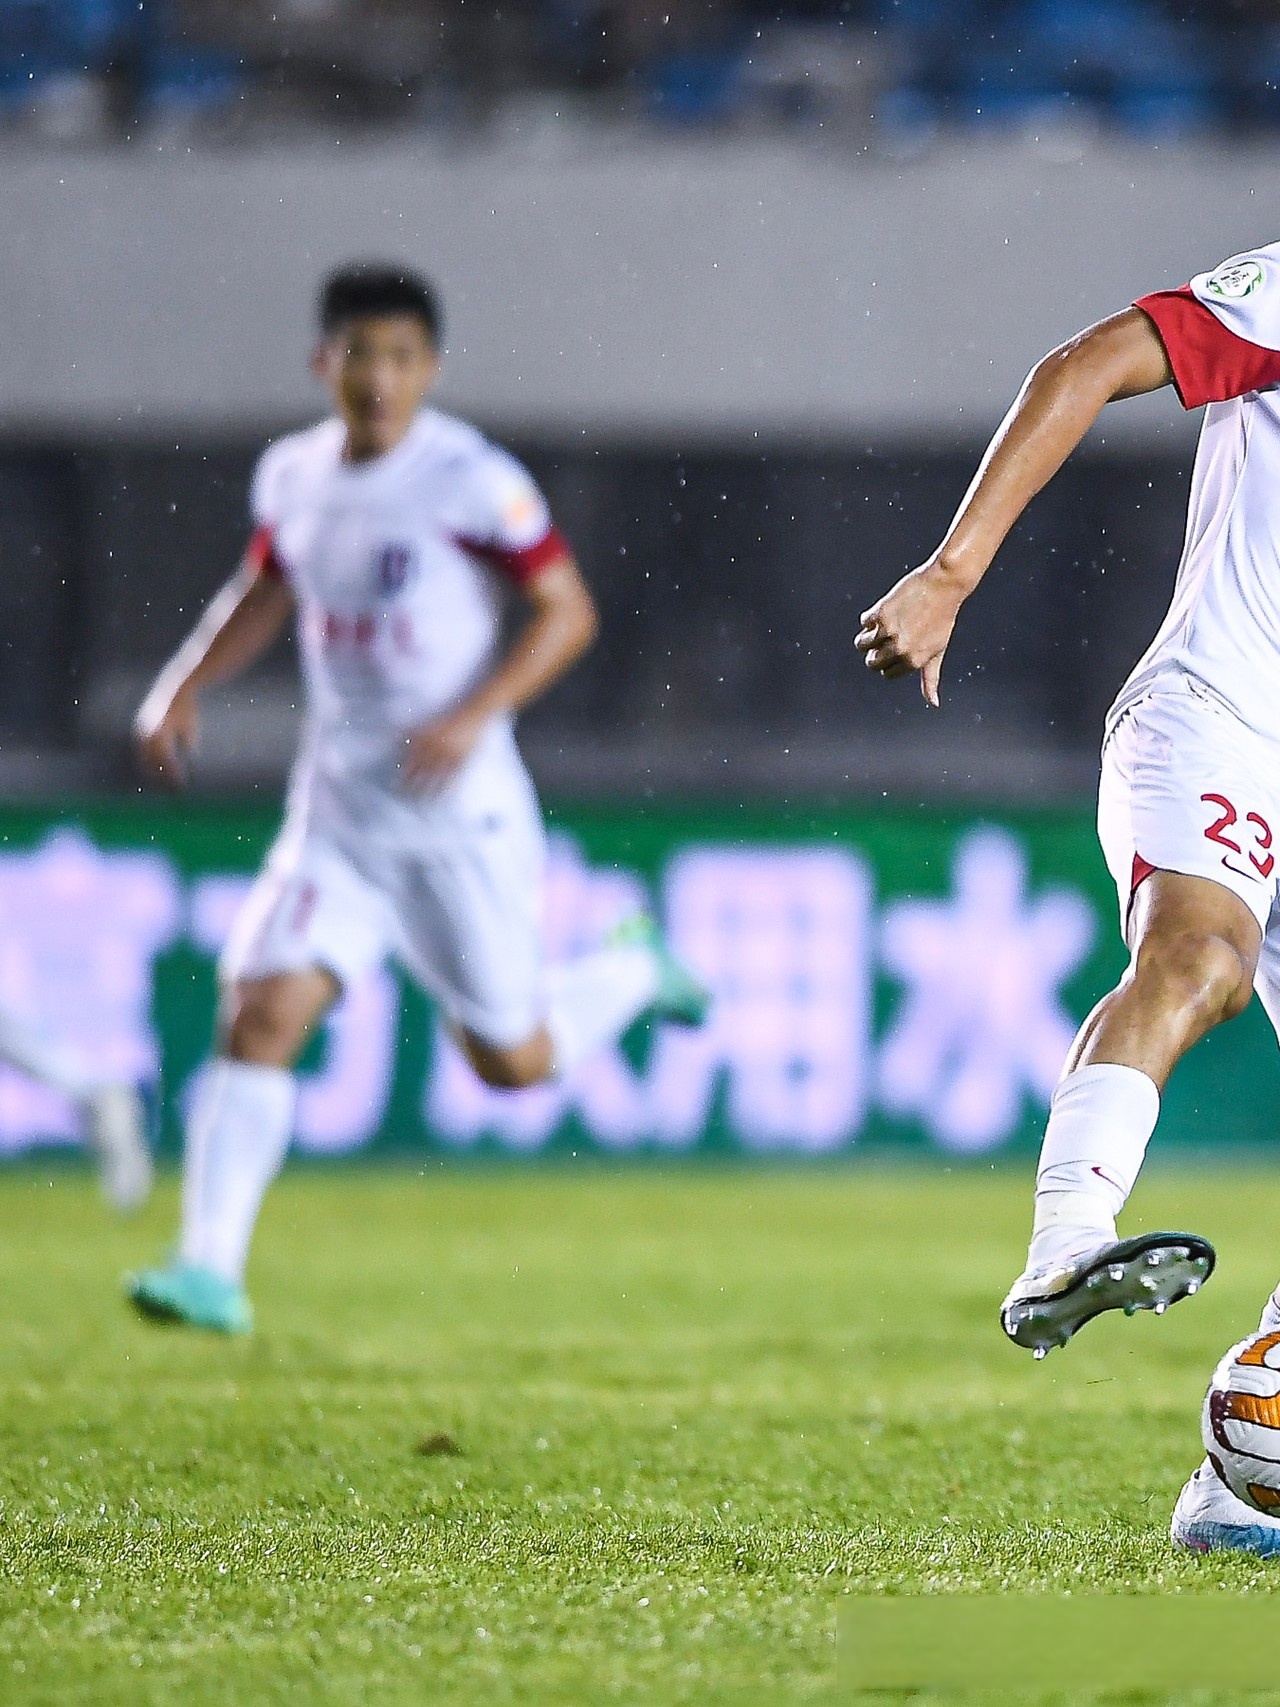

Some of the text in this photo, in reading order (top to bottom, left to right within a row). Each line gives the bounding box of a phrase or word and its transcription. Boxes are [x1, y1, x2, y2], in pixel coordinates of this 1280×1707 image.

[1200, 793, 1274, 878] 23
[0, 824, 1102, 1152] 官用水
